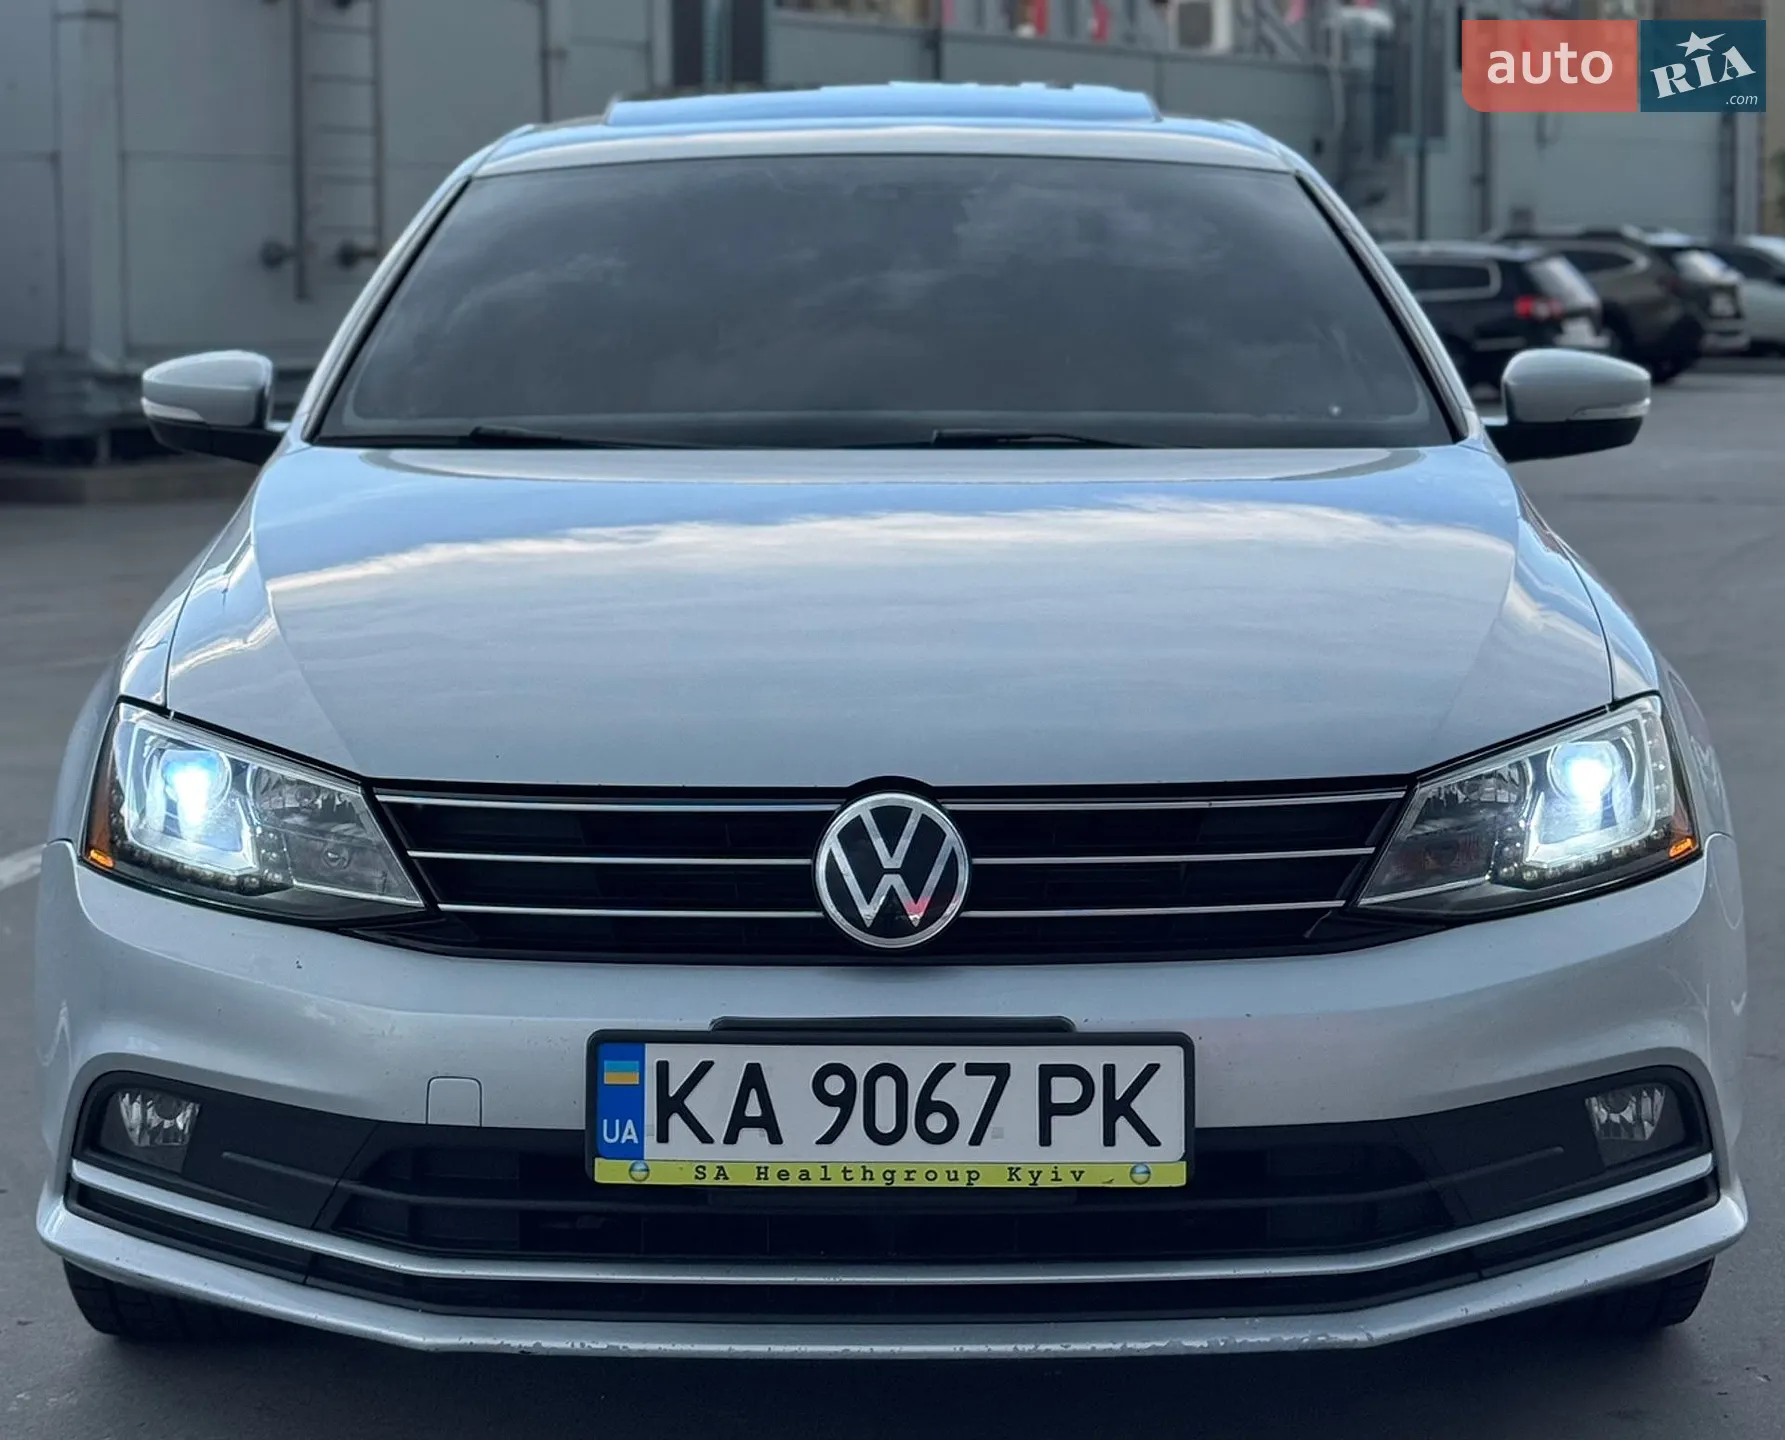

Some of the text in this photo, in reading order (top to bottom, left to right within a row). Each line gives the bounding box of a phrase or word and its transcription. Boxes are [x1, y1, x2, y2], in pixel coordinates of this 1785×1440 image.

[824, 798, 960, 928] VW
[603, 1119, 638, 1144] UA
[655, 1060, 1162, 1147] KA 9067 PK
[693, 1164, 1087, 1186] SA Healthgroup Kyiv
